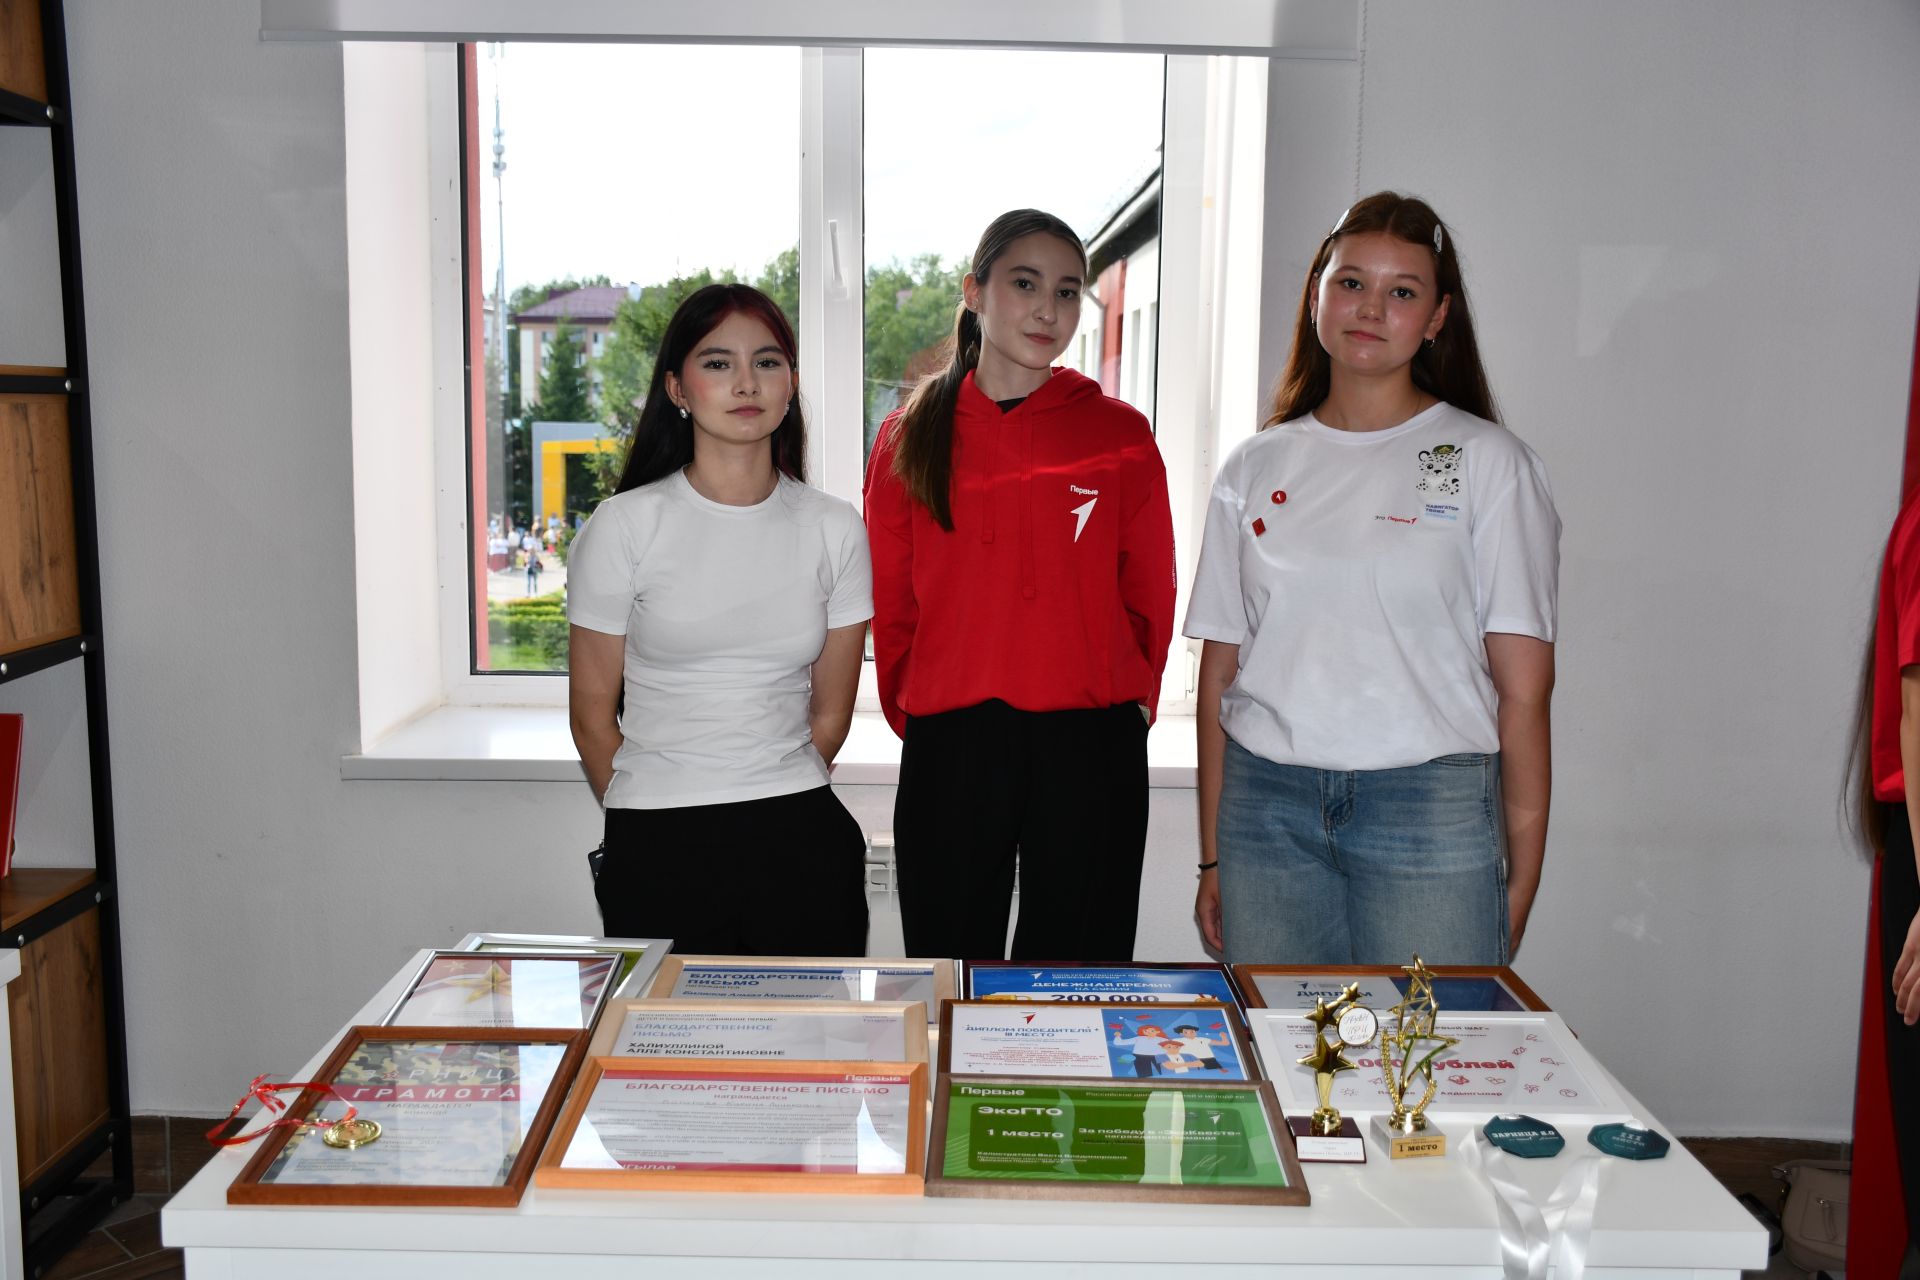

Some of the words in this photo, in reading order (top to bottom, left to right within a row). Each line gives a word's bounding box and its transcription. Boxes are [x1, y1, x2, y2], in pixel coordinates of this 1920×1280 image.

[1070, 485, 1099, 496] Первые
[1109, 994, 1159, 1002] 000
[1296, 990, 1374, 998] ДИПЛМ
[635, 1023, 773, 1031] БЛАГОДАРСТВЕННОЕ
[1415, 1058, 1514, 1071] ублей
[363, 1069, 521, 1081] ЗРНИЦ
[844, 1074, 902, 1083] Первые
[352, 1088, 516, 1099] ГРАМОТА
[625, 1082, 811, 1093] БЛАГОДАРСТВЕННОЕ
[815, 1086, 889, 1095] ПИСЬМО
[960, 1086, 1025, 1097] Первые
[978, 1106, 1063, 1116] ЭкоГТО
[987, 1128, 994, 1136] 1
[1002, 1130, 1065, 1138] место
[1407, 1144, 1438, 1152] место
